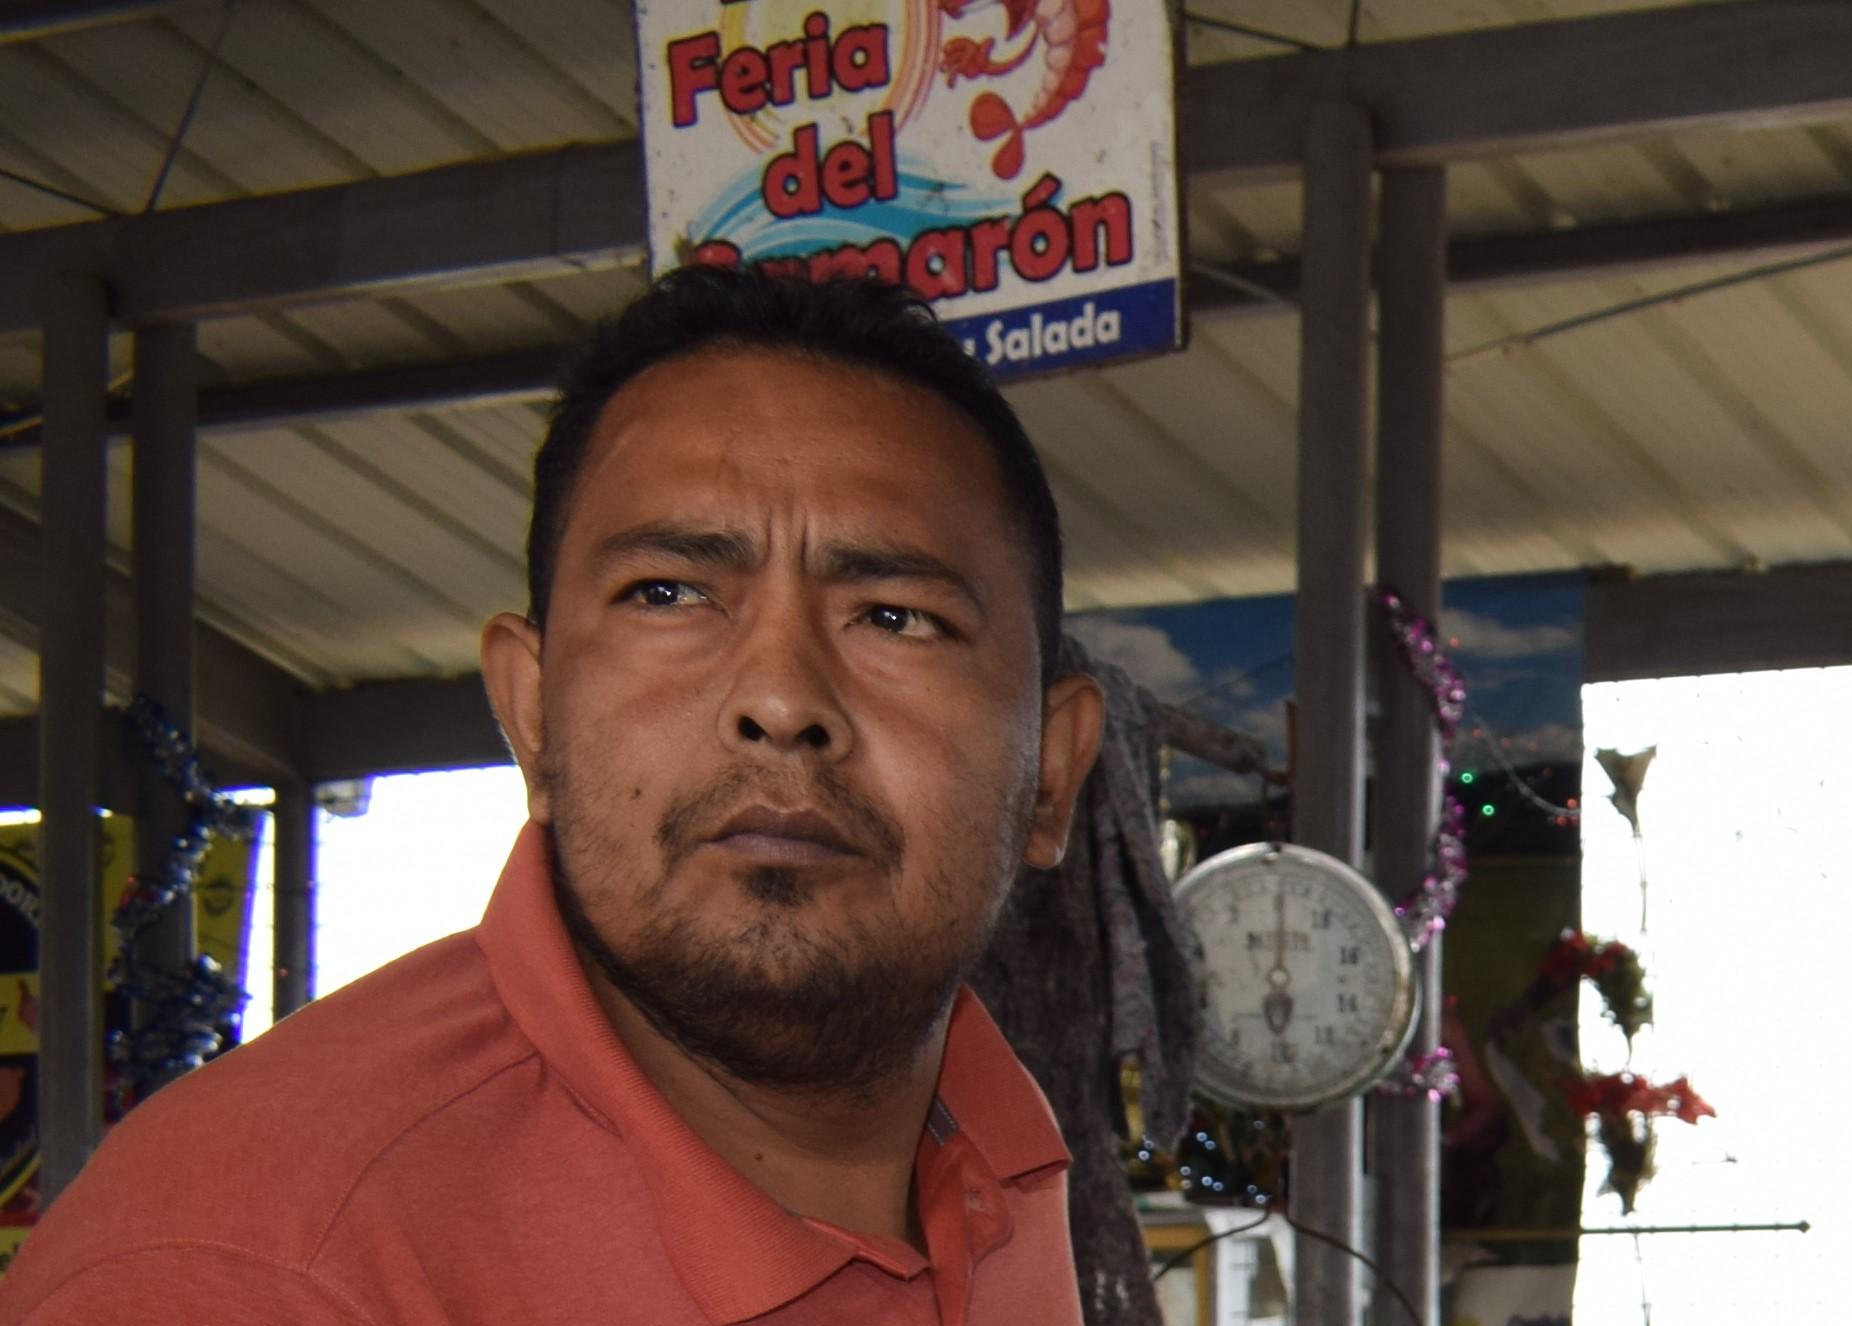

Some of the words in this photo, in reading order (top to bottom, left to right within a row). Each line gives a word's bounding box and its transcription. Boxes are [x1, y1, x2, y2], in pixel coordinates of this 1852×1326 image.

[667, 11, 891, 128] Feria
[763, 110, 898, 219] del
[693, 172, 1133, 301] marón
[986, 302, 1121, 366] Salada
